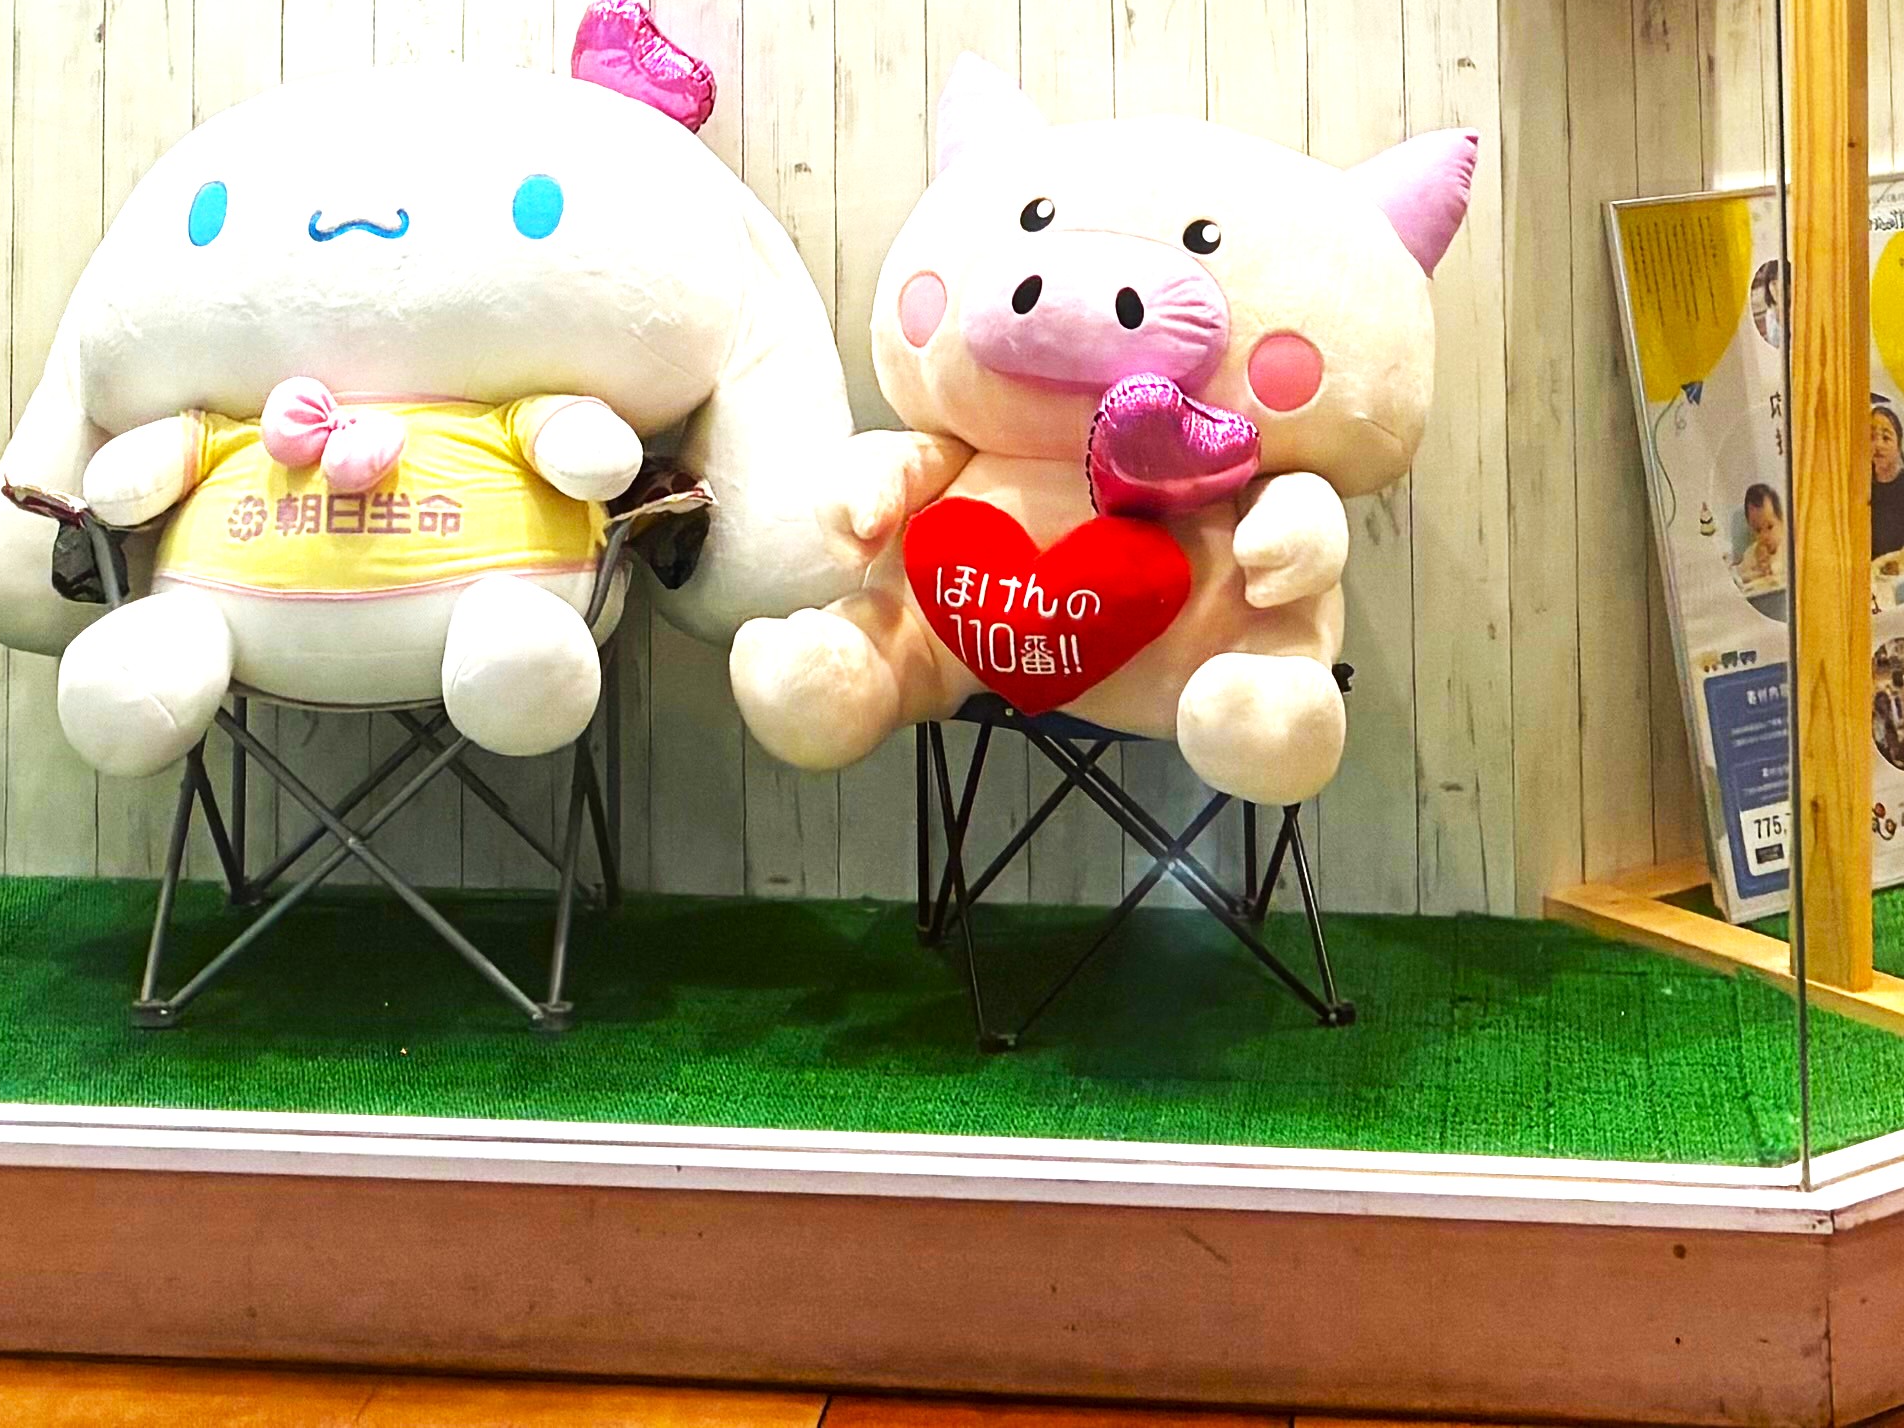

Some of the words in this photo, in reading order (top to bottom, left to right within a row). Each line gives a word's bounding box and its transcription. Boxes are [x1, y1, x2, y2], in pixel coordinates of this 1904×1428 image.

[275, 491, 464, 537] 朝日生命
[936, 565, 1101, 620] ほけんの
[949, 614, 1083, 675] 110番!!
